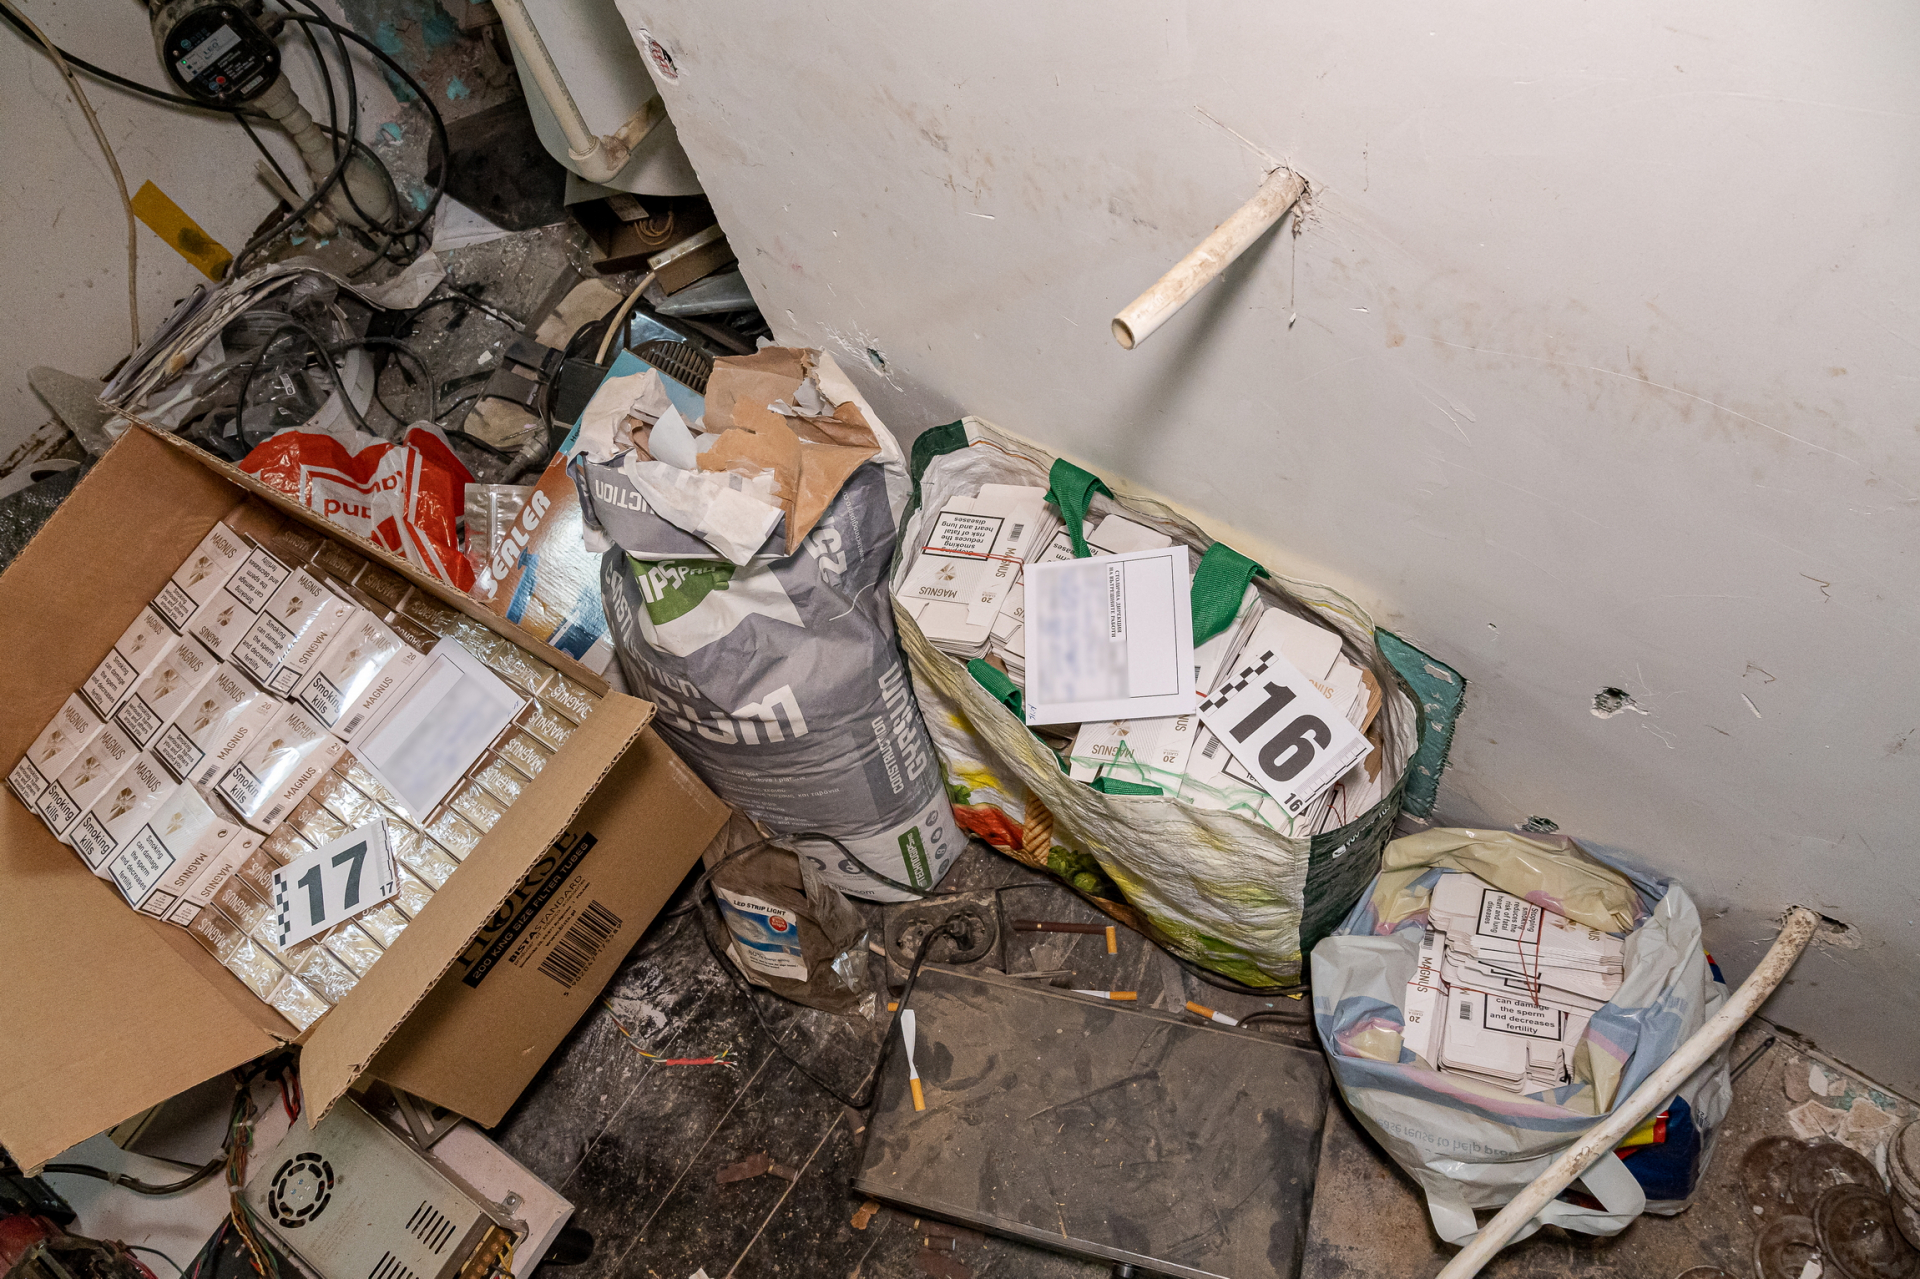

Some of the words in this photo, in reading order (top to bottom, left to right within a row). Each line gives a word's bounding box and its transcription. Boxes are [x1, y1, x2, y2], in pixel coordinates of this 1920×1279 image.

[941, 521, 958, 529] lung
[954, 517, 986, 525] diseases
[210, 532, 238, 558] MAGNUS
[487, 489, 551, 599] SEALER
[944, 541, 976, 549] smoking
[248, 558, 270, 578] decreases
[261, 556, 278, 572] fertility
[1109, 567, 1113, 575] НА
[238, 575, 254, 591] damage
[246, 570, 261, 583] sperm
[259, 581, 268, 590] the
[268, 576, 280, 585] and
[298, 574, 322, 597] MAGNUS
[173, 587, 188, 604] Smoking
[235, 585, 254, 605] Smoking
[253, 588, 264, 599] can
[919, 586, 958, 598] MAGNUS
[160, 601, 171, 614] around
[170, 612, 178, 620] you
[166, 599, 176, 608] and
[174, 606, 184, 618] others
[178, 601, 189, 614] harms
[144, 614, 164, 636] MAGNUS
[266, 620, 286, 640] Smoking
[199, 626, 222, 648] MAGNUS
[252, 634, 260, 642] the
[259, 639, 275, 657] sperm
[257, 626, 266, 634] can
[265, 632, 284, 650] damage
[298, 631, 328, 664] MAGNUS
[361, 623, 392, 651] MAGNUS
[176, 644, 204, 672] MAGNUS
[242, 640, 252, 649] and
[251, 646, 274, 668] decreases
[243, 653, 260, 670] fertility
[406, 652, 417, 661] 20
[113, 656, 129, 676] Smoking
[106, 677, 118, 692] sperm
[110, 668, 125, 686] damage
[91, 688, 103, 706] fertility
[97, 681, 115, 704] decreases
[216, 673, 246, 703] MAGNUS
[313, 678, 342, 714] Smoking
[363, 676, 394, 710] MAGNUS
[137, 702, 152, 720] Smoking
[261, 702, 272, 710] 20
[311, 694, 328, 714] kills
[550, 686, 590, 720] MAGNUS
[63, 705, 89, 734] MAGNUS
[124, 709, 132, 717] you
[132, 716, 140, 724] and
[138, 723, 148, 735] others
[124, 716, 135, 730] around
[134, 728, 142, 737] you
[142, 717, 154, 731] harms
[284, 713, 316, 740] MAGNUS
[528, 712, 568, 742] MAGNUS
[878, 662, 927, 781] GYPSUM
[1229, 681, 1332, 782] 16
[99, 731, 126, 760] MAGNUS
[163, 741, 171, 749] you
[170, 748, 179, 756] and
[178, 754, 189, 767] others
[167, 734, 182, 752] seriously
[182, 751, 194, 763] harms
[176, 734, 192, 753] Smoking
[217, 727, 248, 760] MAGNUS
[1092, 744, 1134, 758] MAGNUS
[163, 748, 174, 762] around
[173, 760, 182, 769] you
[508, 739, 544, 771] MAGNUS
[26, 764, 40, 782] Smoking
[134, 761, 162, 792] MAGNUS
[283, 767, 317, 800] MAGNUS
[14, 779, 24, 792] around
[22, 790, 30, 798] you
[229, 784, 247, 804] kills
[45, 802, 59, 822] kills
[48, 785, 74, 822] Smoking
[1284, 793, 1303, 812] 16
[79, 835, 95, 855] kills
[82, 816, 110, 855] Smoking
[136, 840, 144, 851] can
[142, 849, 159, 871] damage
[146, 835, 164, 860] Smoking
[120, 855, 128, 865] and
[127, 864, 146, 891] decreases
[130, 851, 138, 861] the
[136, 860, 150, 877] sperm
[174, 852, 209, 887] MAGNUS
[119, 870, 133, 891] fertility
[200, 864, 233, 897] MAGNUS
[298, 840, 368, 926] 17
[380, 881, 394, 897] 17
[222, 889, 253, 919] MAGNUS
[473, 958, 492, 979] 200
[493, 934, 513, 957] KING
[514, 909, 533, 931] SIZE
[534, 875, 561, 907] FILTER
[560, 842, 588, 873] TUBES
[733, 900, 746, 908] LED
[747, 903, 766, 911] STRIP
[766, 907, 786, 916] LIGHT
[1484, 901, 1493, 924] diseases
[1512, 902, 1521, 923] reduces
[509, 875, 582, 963] BISTASTANDARD
[1502, 919, 1510, 931] fatal
[1504, 912, 1509, 920] of
[1527, 907, 1538, 932] Stopping
[197, 918, 228, 949] MAGNUS
[1490, 921, 1499, 933] lung
[1510, 924, 1518, 932] the
[572, 956, 596, 986] 902047
[1417, 956, 1434, 993] MAGNUS
[1514, 1000, 1550, 1011] damage
[1516, 1009, 1545, 1018] sperm
[1409, 1016, 1421, 1024] 20
[1490, 1012, 1506, 1020] and
[1508, 1016, 1556, 1028] decreases
[1506, 1023, 1538, 1034] fertility
